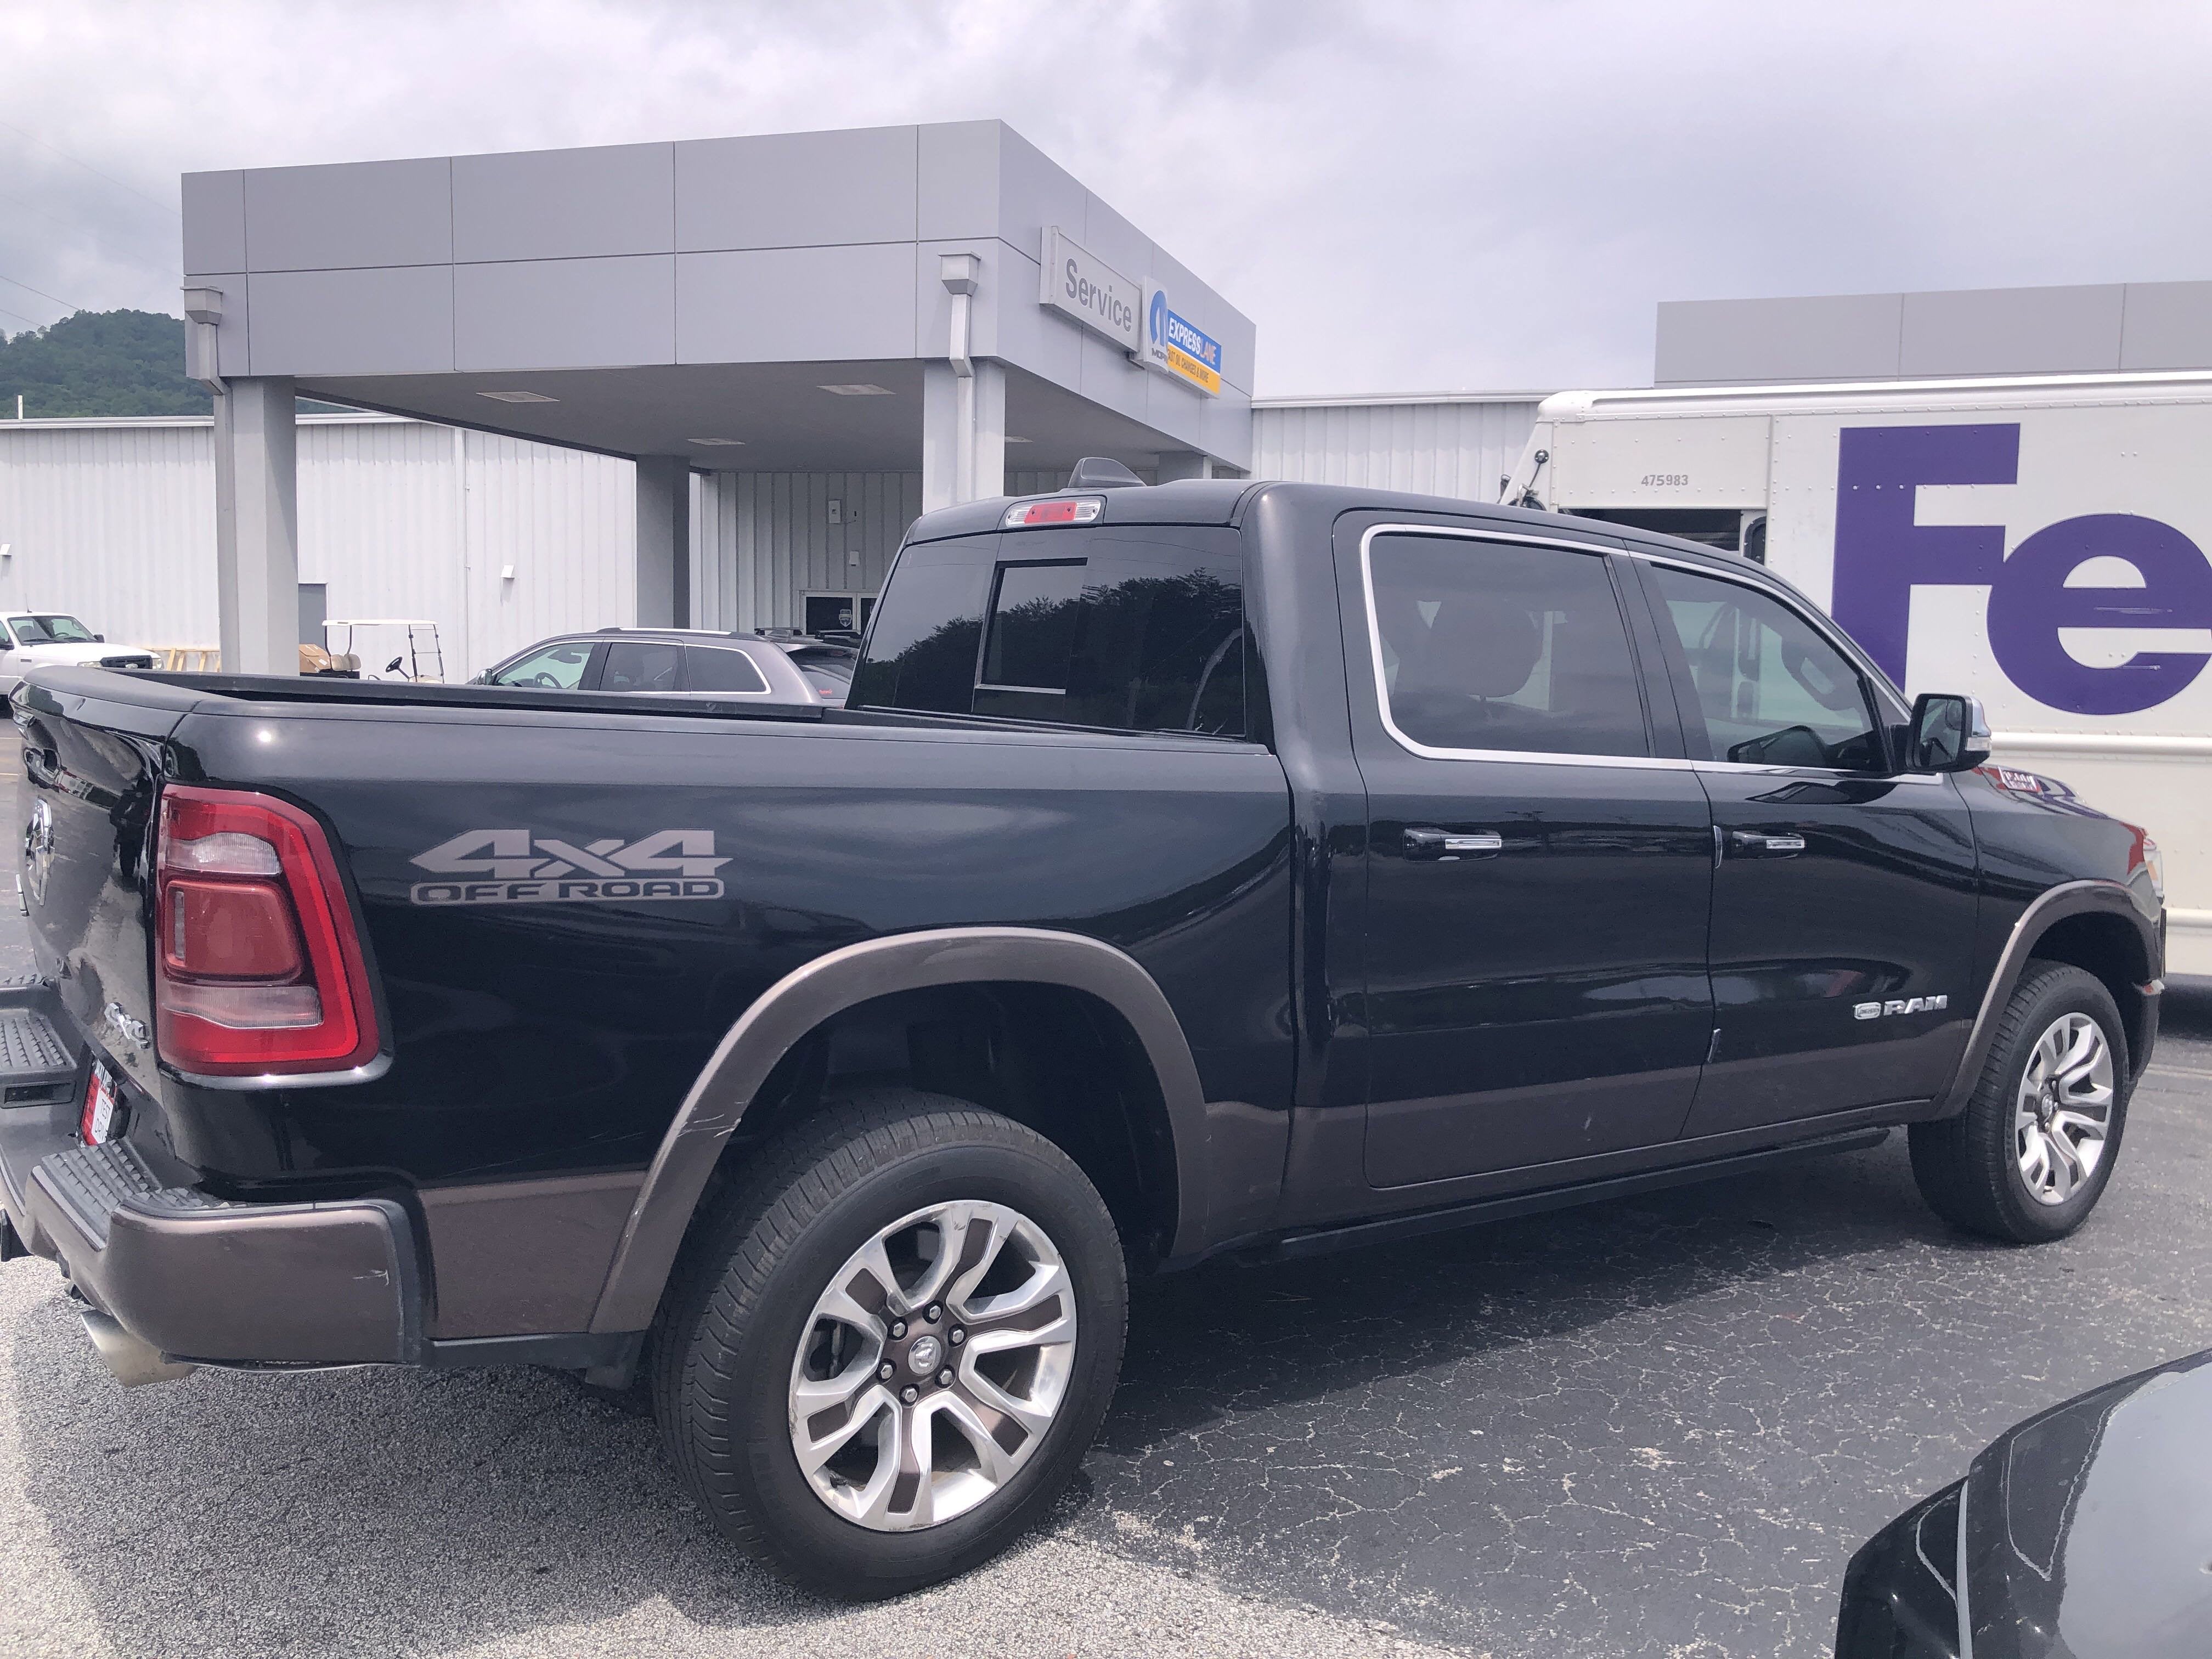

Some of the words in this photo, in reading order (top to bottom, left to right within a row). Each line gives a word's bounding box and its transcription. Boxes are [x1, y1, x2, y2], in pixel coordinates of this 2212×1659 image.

[1065, 258, 1132, 332] Service
[1641, 474, 1689, 487] 475983
[417, 882, 549, 903] OFF
[558, 879, 720, 899] ROAD
[1883, 995, 1948, 1017] RAM
